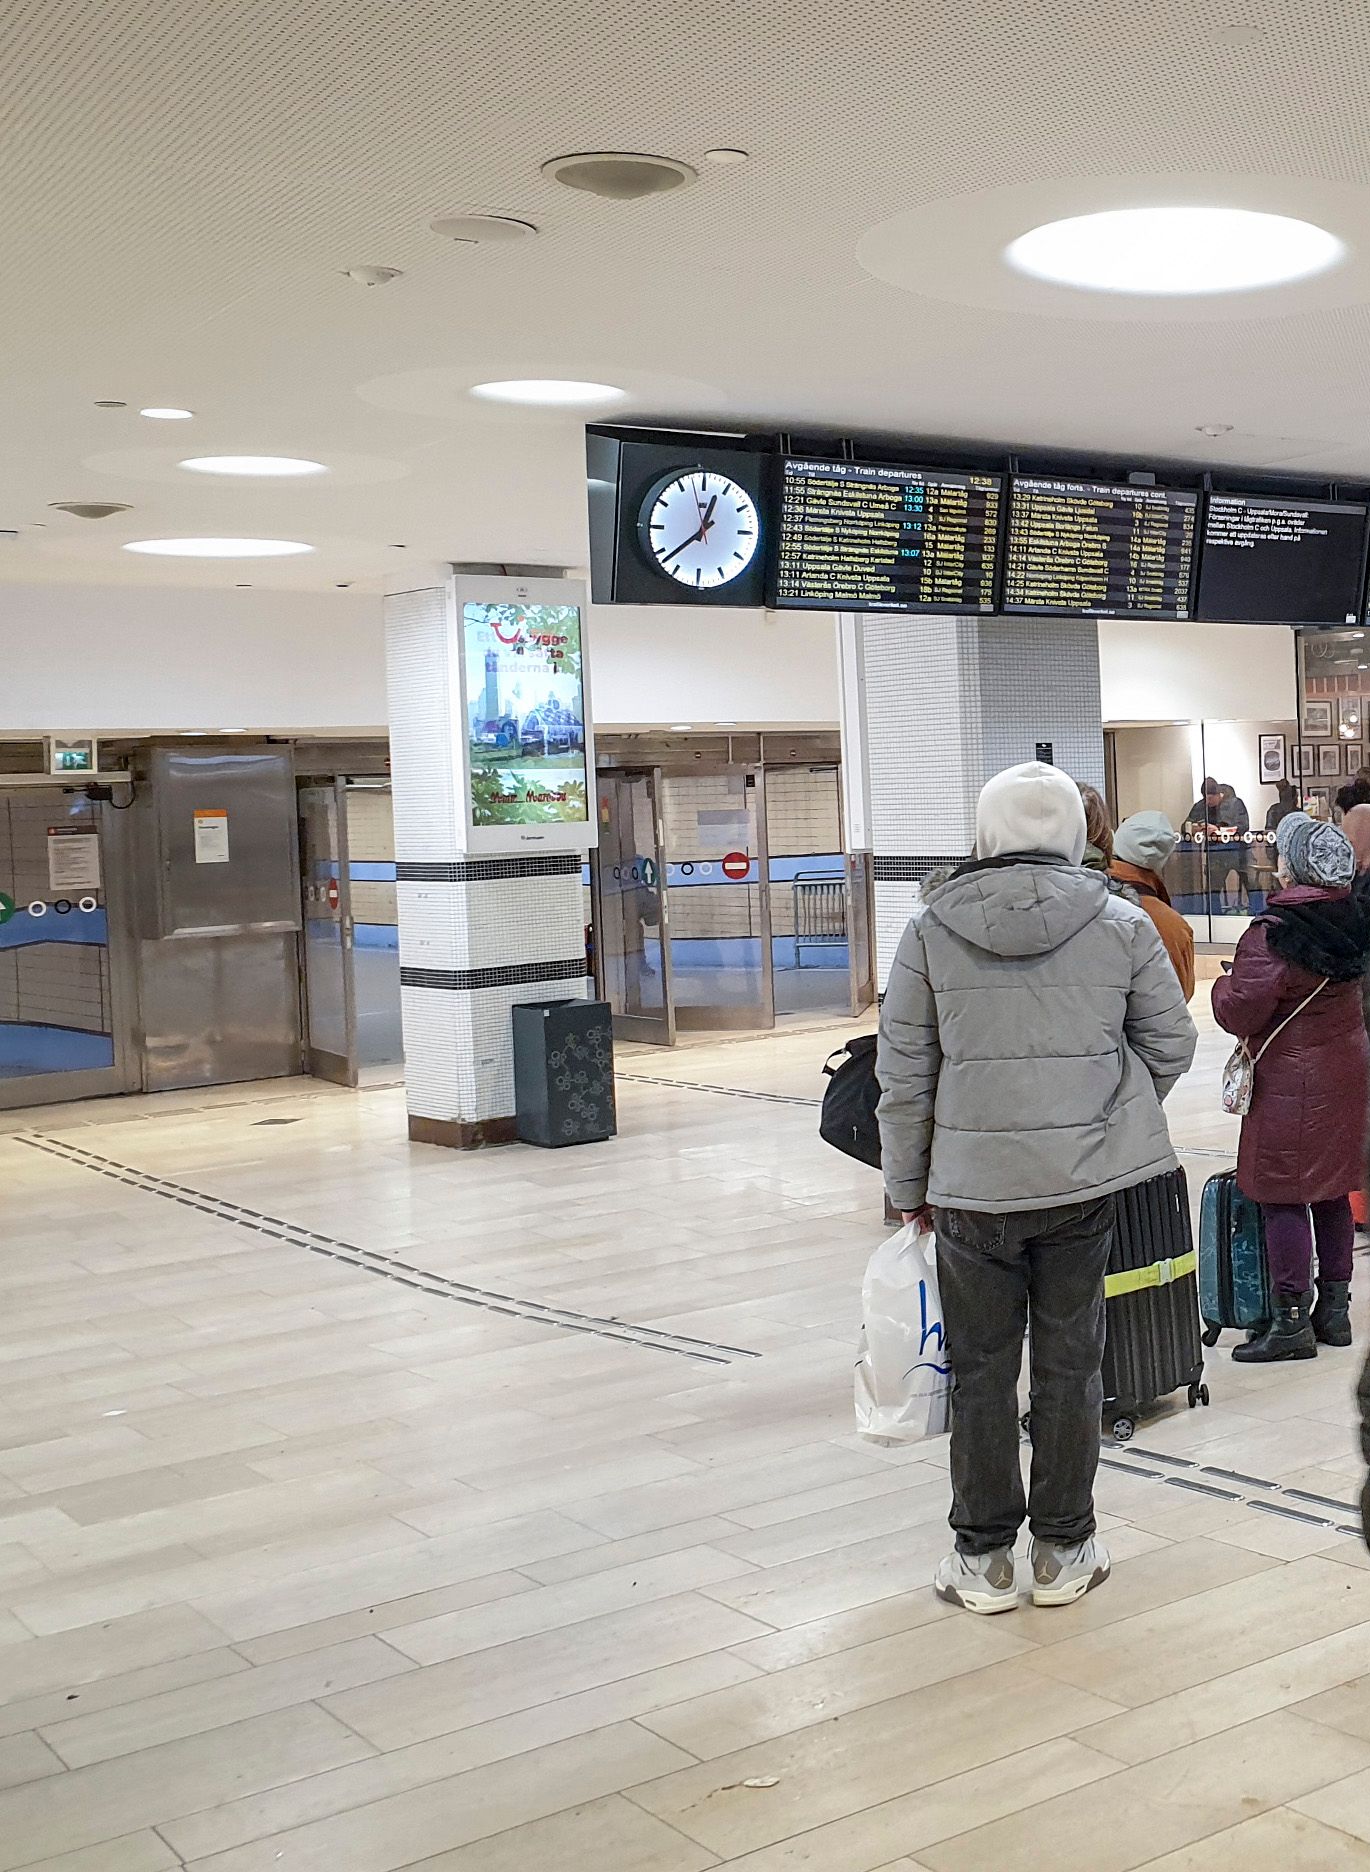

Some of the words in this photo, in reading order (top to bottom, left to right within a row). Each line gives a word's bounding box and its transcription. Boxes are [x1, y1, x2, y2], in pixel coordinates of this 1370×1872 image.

[785, 461, 830, 473] Avgående
[832, 465, 846, 474] tåg
[853, 466, 875, 475] Train
[877, 468, 922, 480] departures
[1013, 479, 1051, 490] Avgående
[1111, 487, 1148, 498] departures
